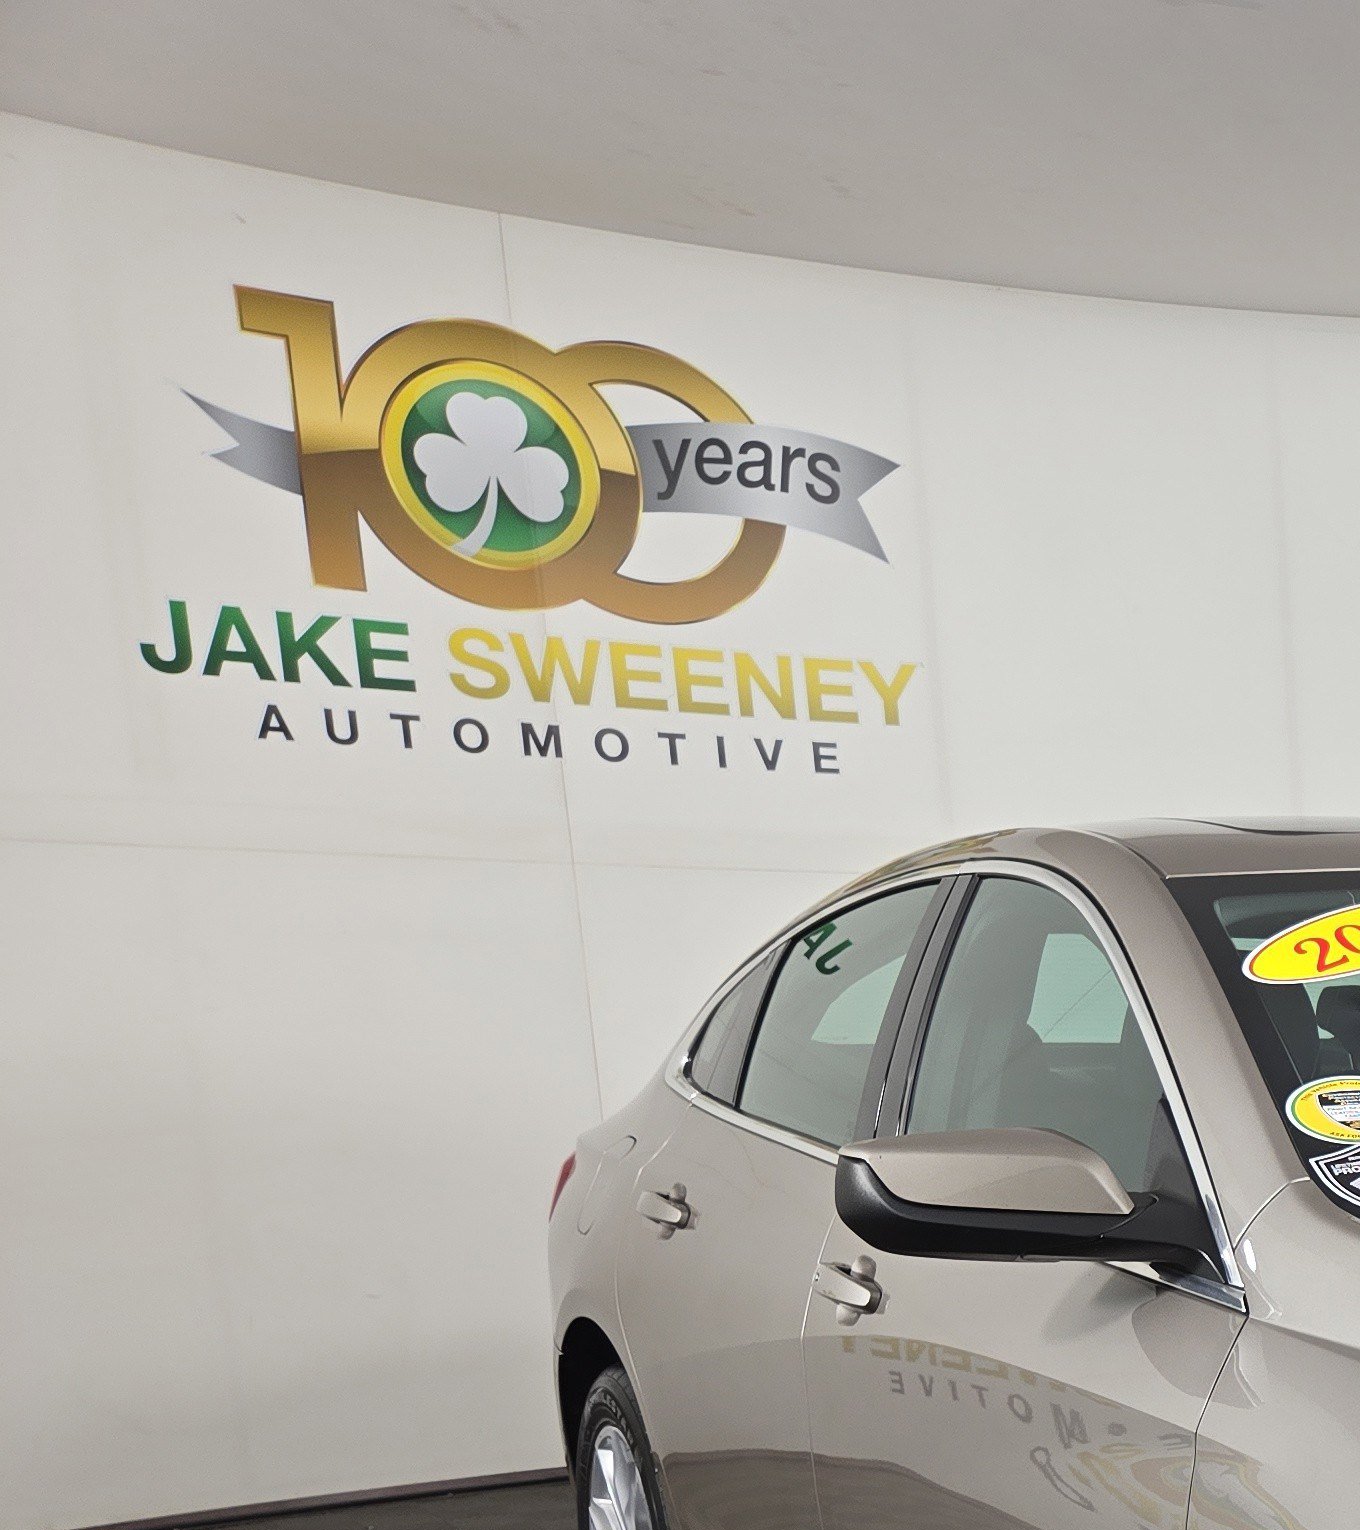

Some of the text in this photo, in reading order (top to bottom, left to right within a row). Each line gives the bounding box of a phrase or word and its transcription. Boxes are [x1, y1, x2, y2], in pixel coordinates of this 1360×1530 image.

[233, 284, 841, 625] 100 years
[139, 600, 917, 726] JAKE SWEENEY
[257, 704, 841, 774] AUTOMOTIVE
